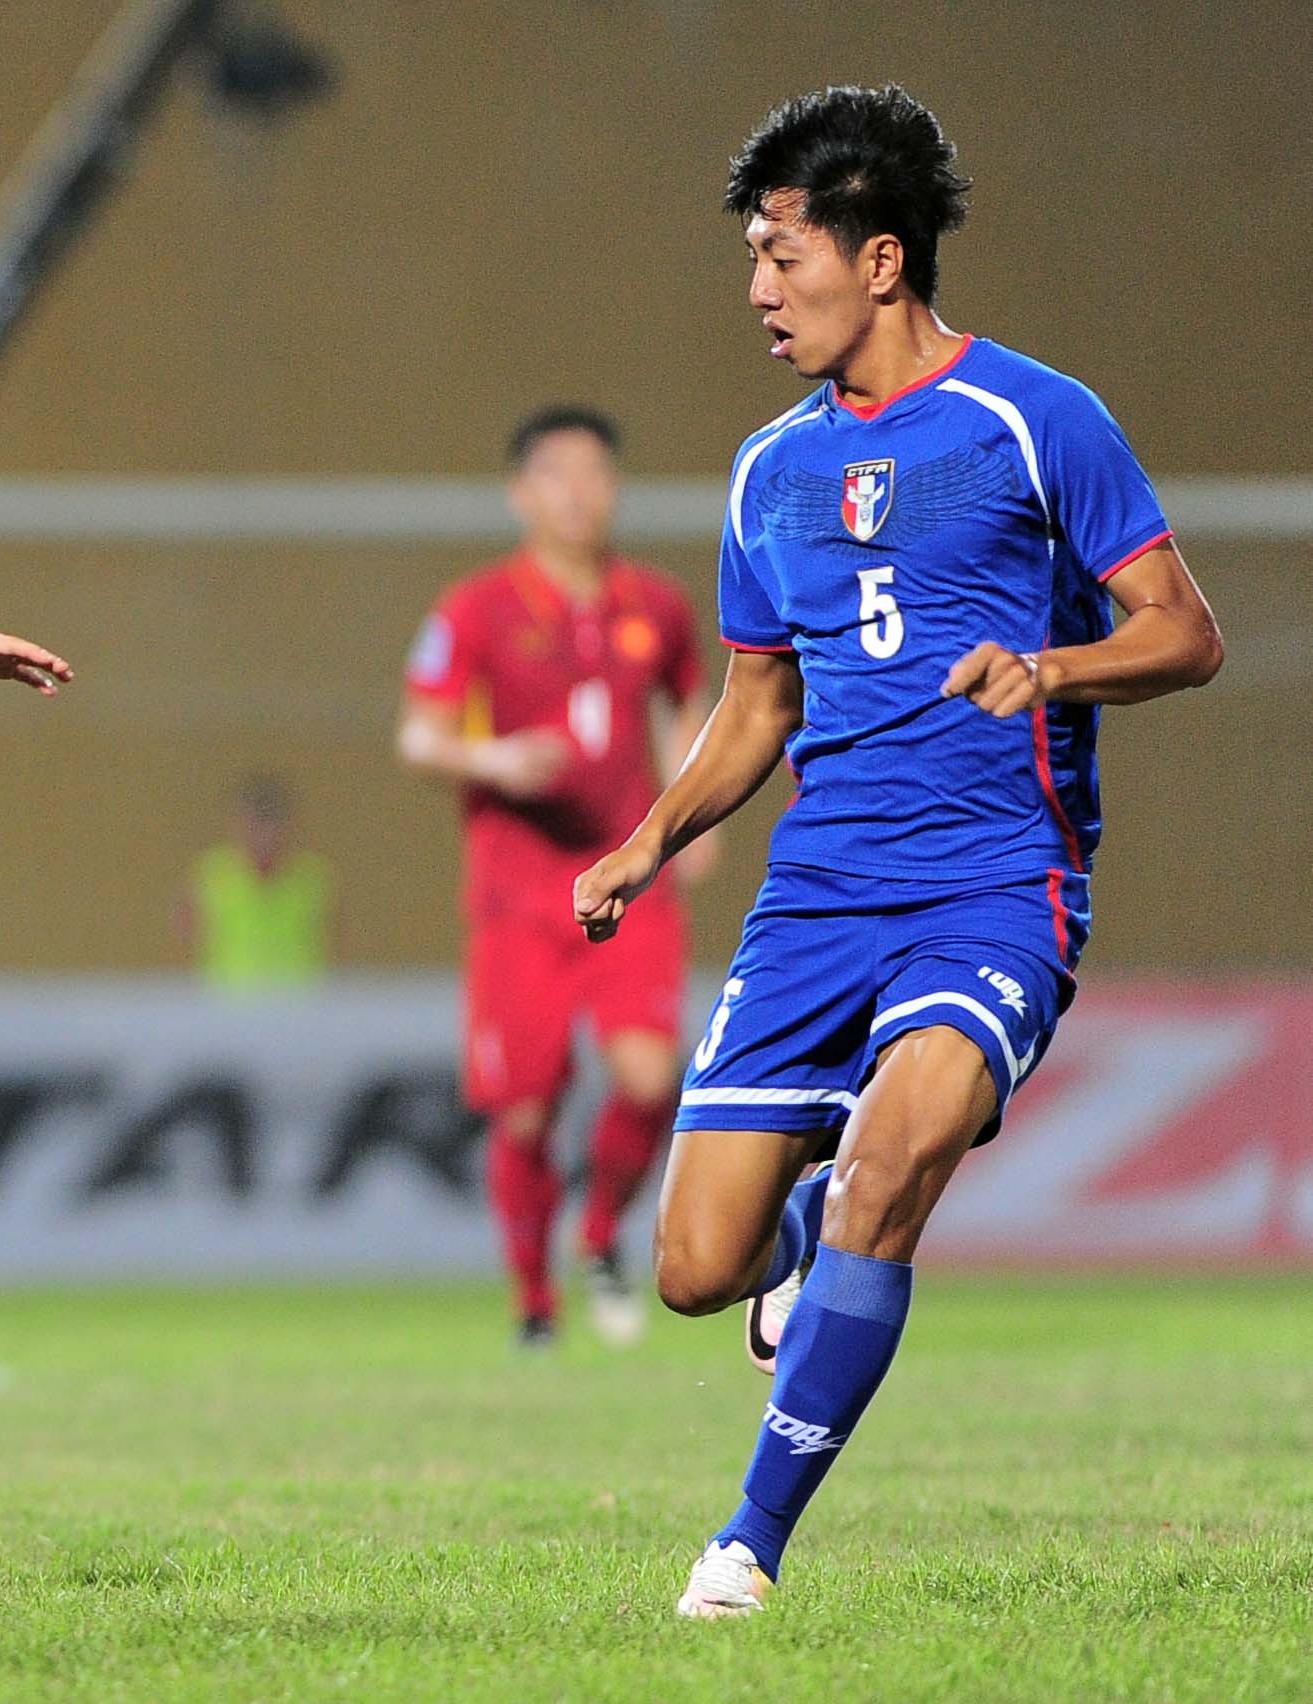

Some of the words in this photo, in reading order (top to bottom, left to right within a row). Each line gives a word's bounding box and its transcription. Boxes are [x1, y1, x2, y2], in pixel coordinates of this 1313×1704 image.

[846, 463, 890, 478] CTFA
[856, 565, 905, 660] 5
[694, 977, 745, 1073] 5
